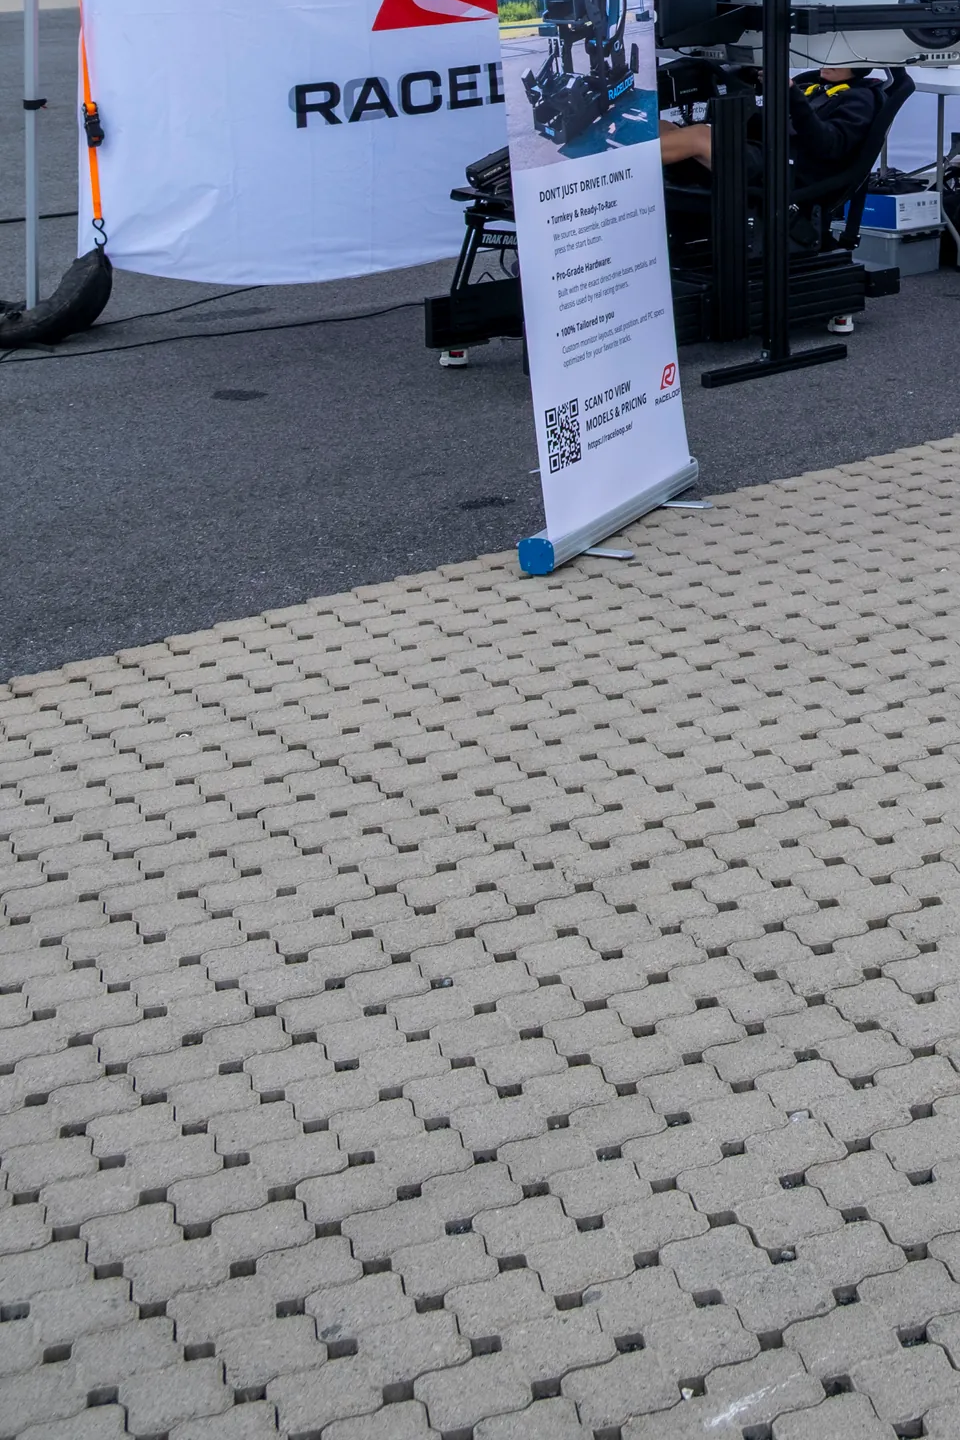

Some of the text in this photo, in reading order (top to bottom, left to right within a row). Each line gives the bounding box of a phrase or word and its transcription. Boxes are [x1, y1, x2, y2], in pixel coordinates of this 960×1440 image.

[608, 76, 634, 100] RACELOOP
[539, 187, 561, 202] DON'T
[562, 183, 578, 199] JUST
[580, 178, 600, 192] DRIVE
[609, 171, 624, 184] OWN
[625, 168, 633, 179] IT.
[552, 211, 573, 225] Turnkey
[574, 210, 579, 218] &
[482, 234, 502, 244] TRAK
[553, 232, 560, 241] We
[554, 247, 566, 257] press
[575, 240, 586, 249] start
[556, 257, 611, 281] Pro-Grade Hardware:
[558, 287, 568, 298] Built
[569, 283, 579, 294] with
[588, 278, 599, 289] exact
[559, 299, 575, 311] chassis
[576, 296, 587, 306] used
[588, 293, 593, 303] by
[594, 290, 602, 300] real
[603, 286, 614, 297] racing
[561, 323, 575, 337] 100%
[577, 316, 598, 331] Tailored
[606, 311, 614, 324] you
[562, 341, 579, 354] Custom
[580, 335, 597, 348] monitor
[614, 326, 622, 335] seat
[648, 312, 653, 321] PC
[654, 308, 664, 321] specs
[564, 352, 585, 368] optimized
[593, 346, 603, 357] your
[603, 340, 620, 353] favorite
[585, 380, 631, 411] SCAN TO VIEW
[586, 393, 647, 431] MODELS & PRICING
